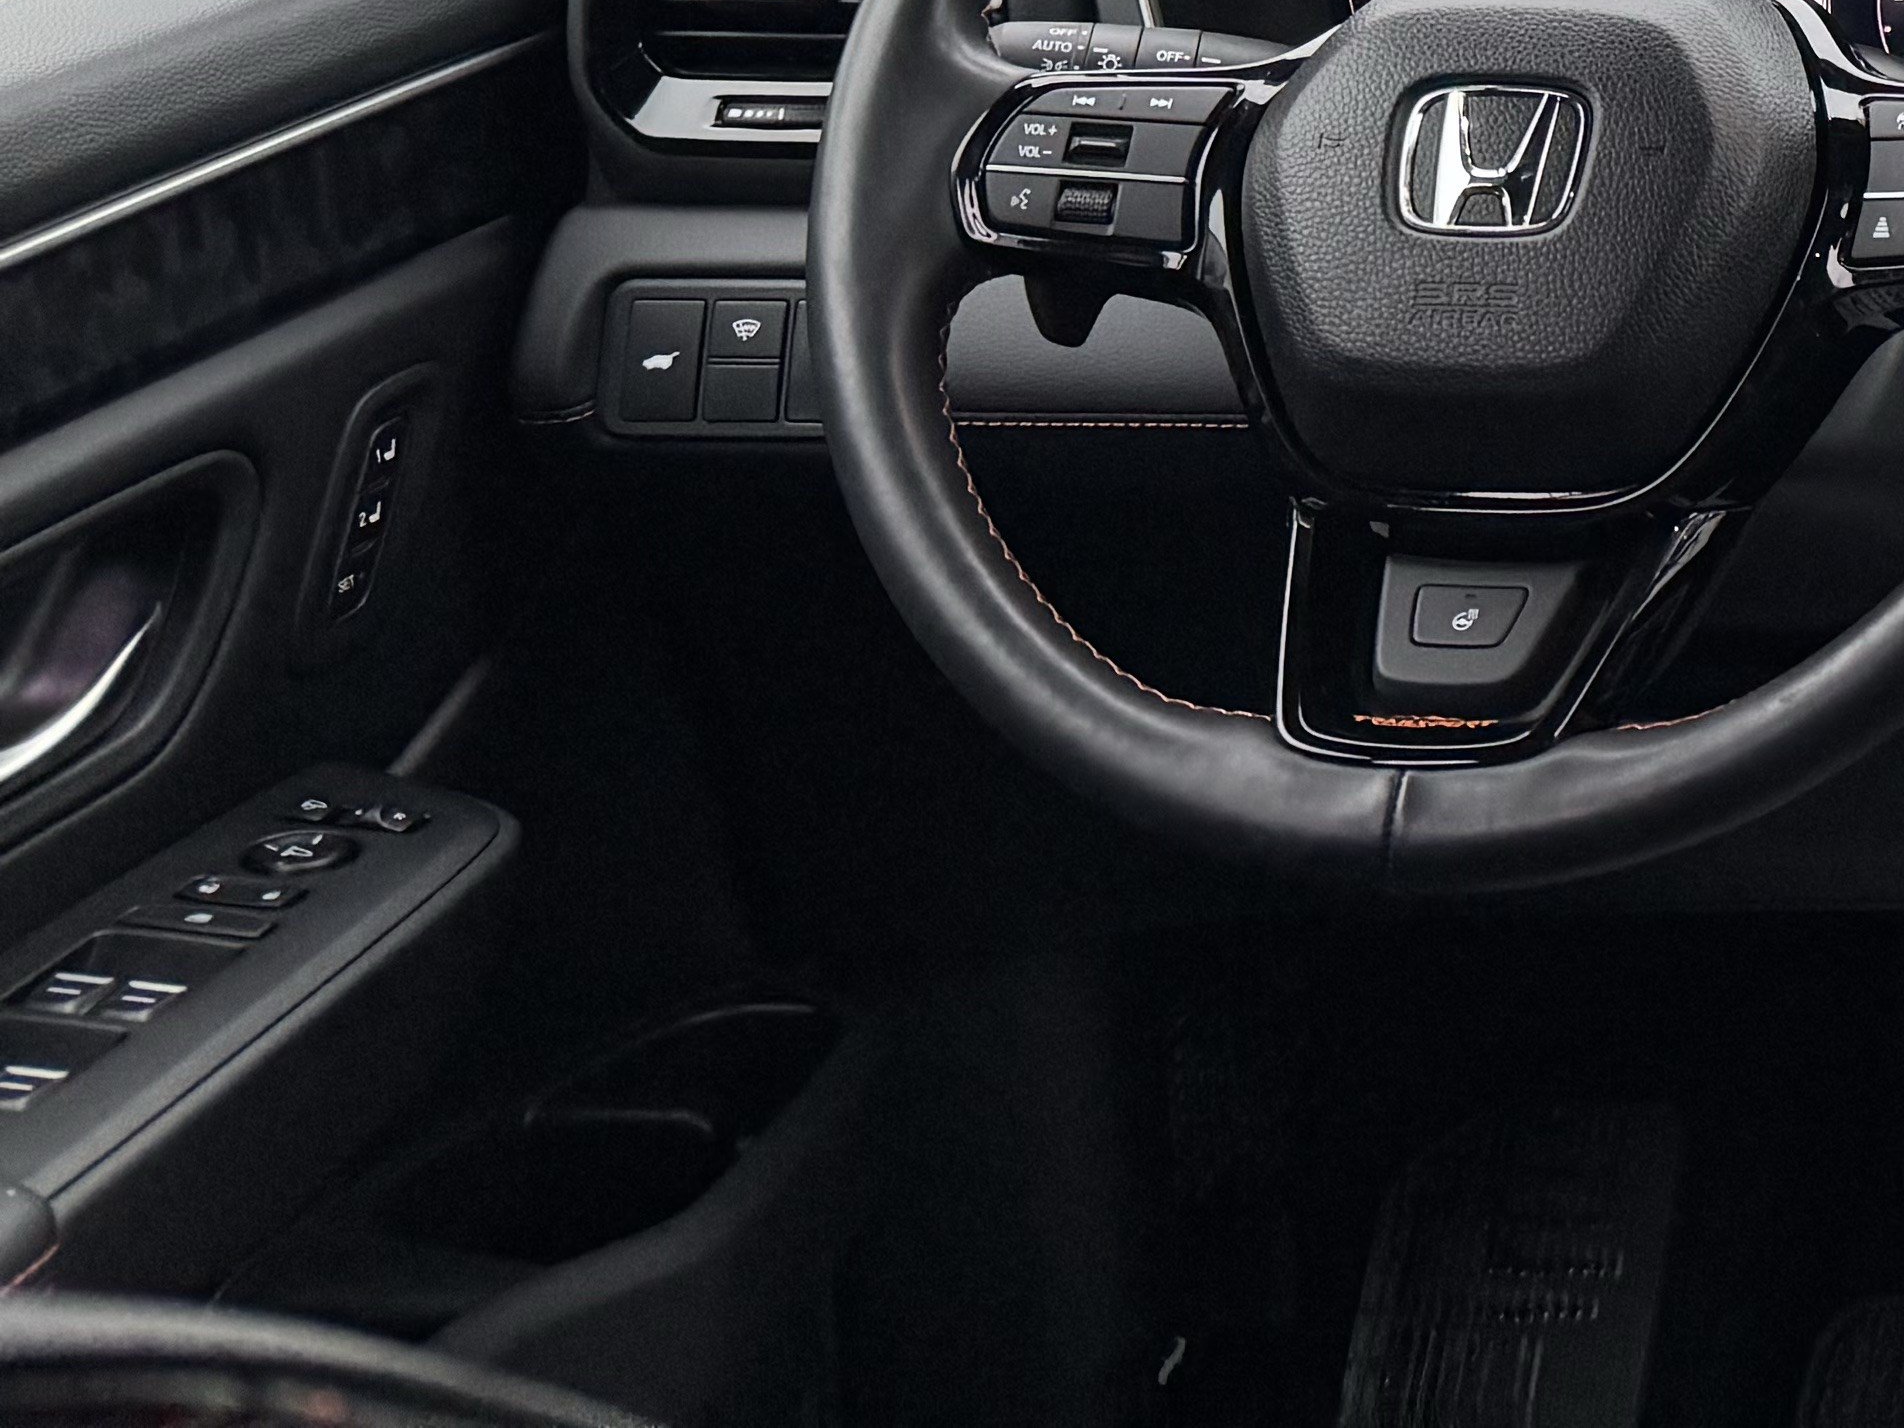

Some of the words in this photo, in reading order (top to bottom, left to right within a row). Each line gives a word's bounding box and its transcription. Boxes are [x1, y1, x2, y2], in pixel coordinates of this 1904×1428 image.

[1050, 26, 1078, 36] OFF
[1032, 40, 1073, 53] AUTO
[1156, 50, 1185, 63] OFF
[358, 512, 367, 527] 2
